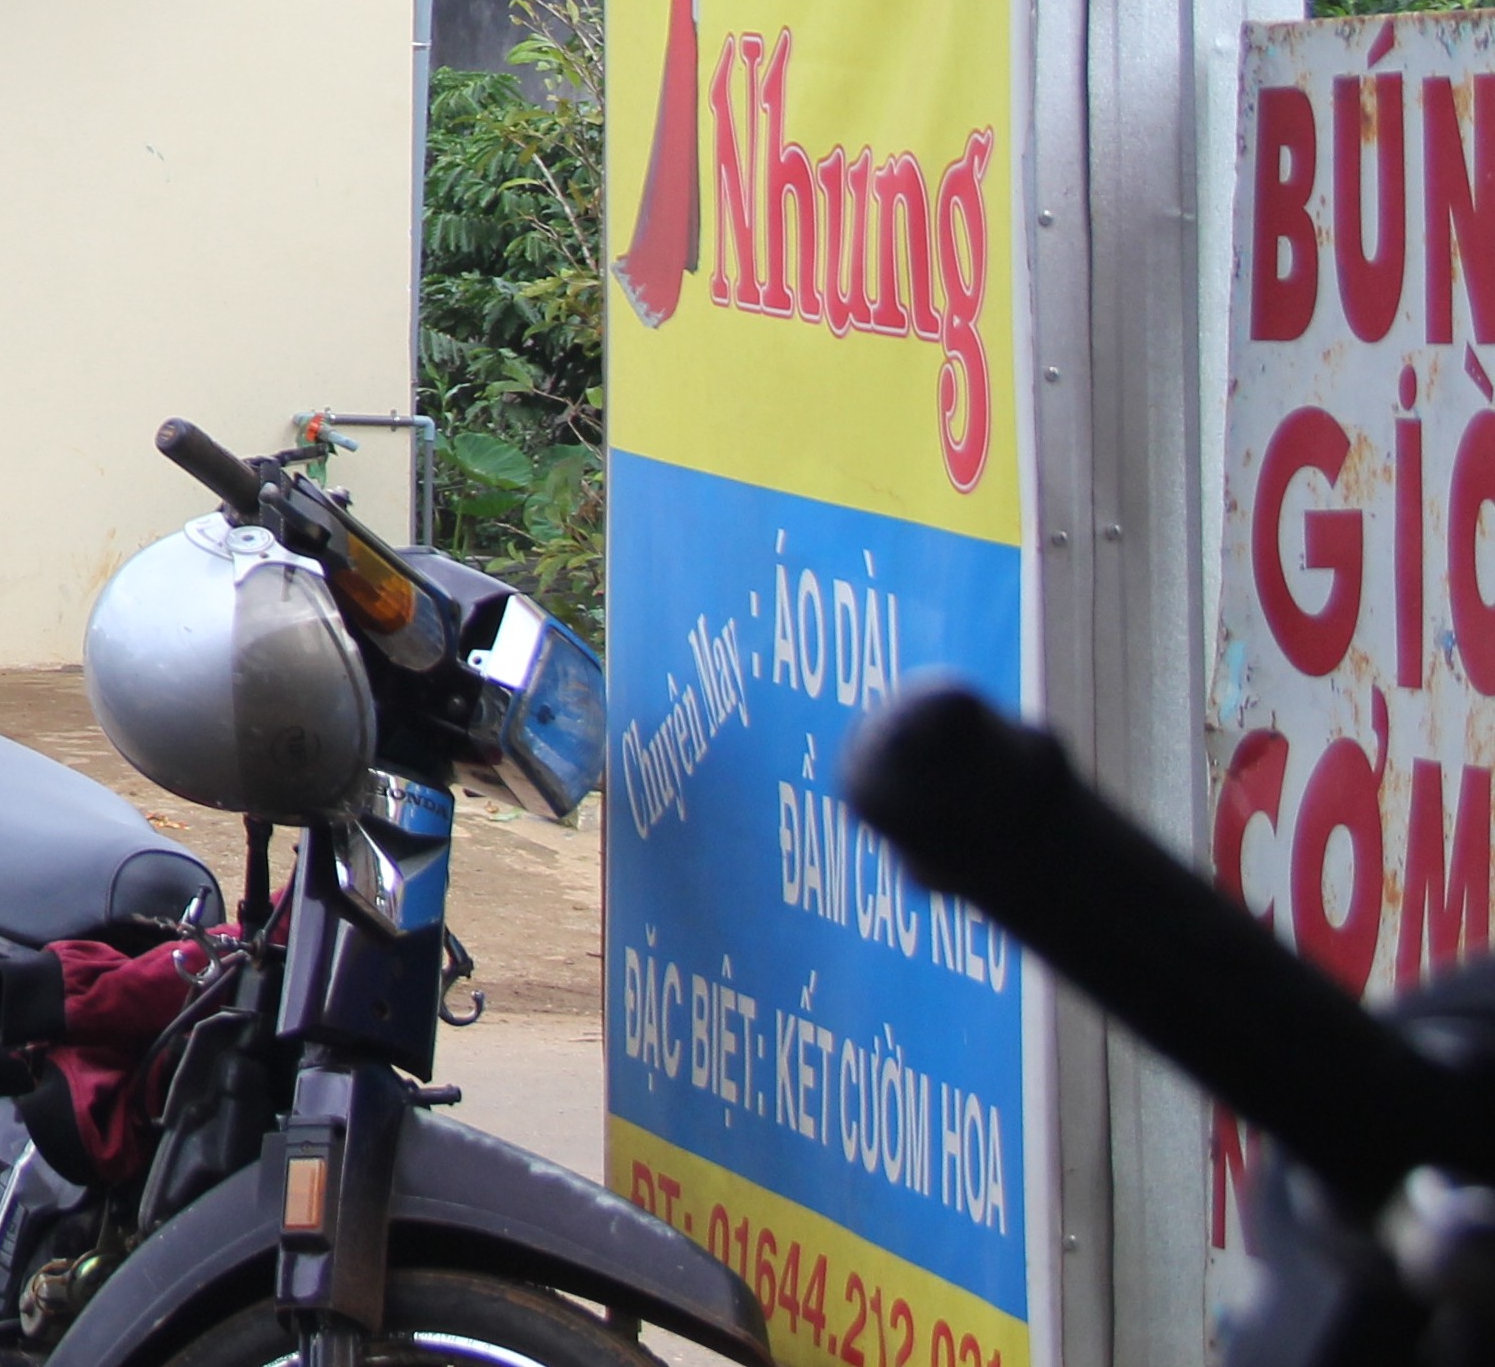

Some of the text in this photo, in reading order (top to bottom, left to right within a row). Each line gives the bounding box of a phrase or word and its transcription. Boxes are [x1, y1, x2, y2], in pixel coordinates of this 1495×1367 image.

[710, 26, 994, 495] Nhung
[1250, 21, 1495, 346] BÚN
[622, 672, 707, 839] Chuyên
[687, 612, 749, 738] May
[773, 528, 826, 698] ÁO
[833, 549, 898, 713] DÀI
[779, 733, 847, 926] ĐẦM
[624, 923, 1006, 1236] ĐẶC BIỆT: KẾT CƯỜM HOA
